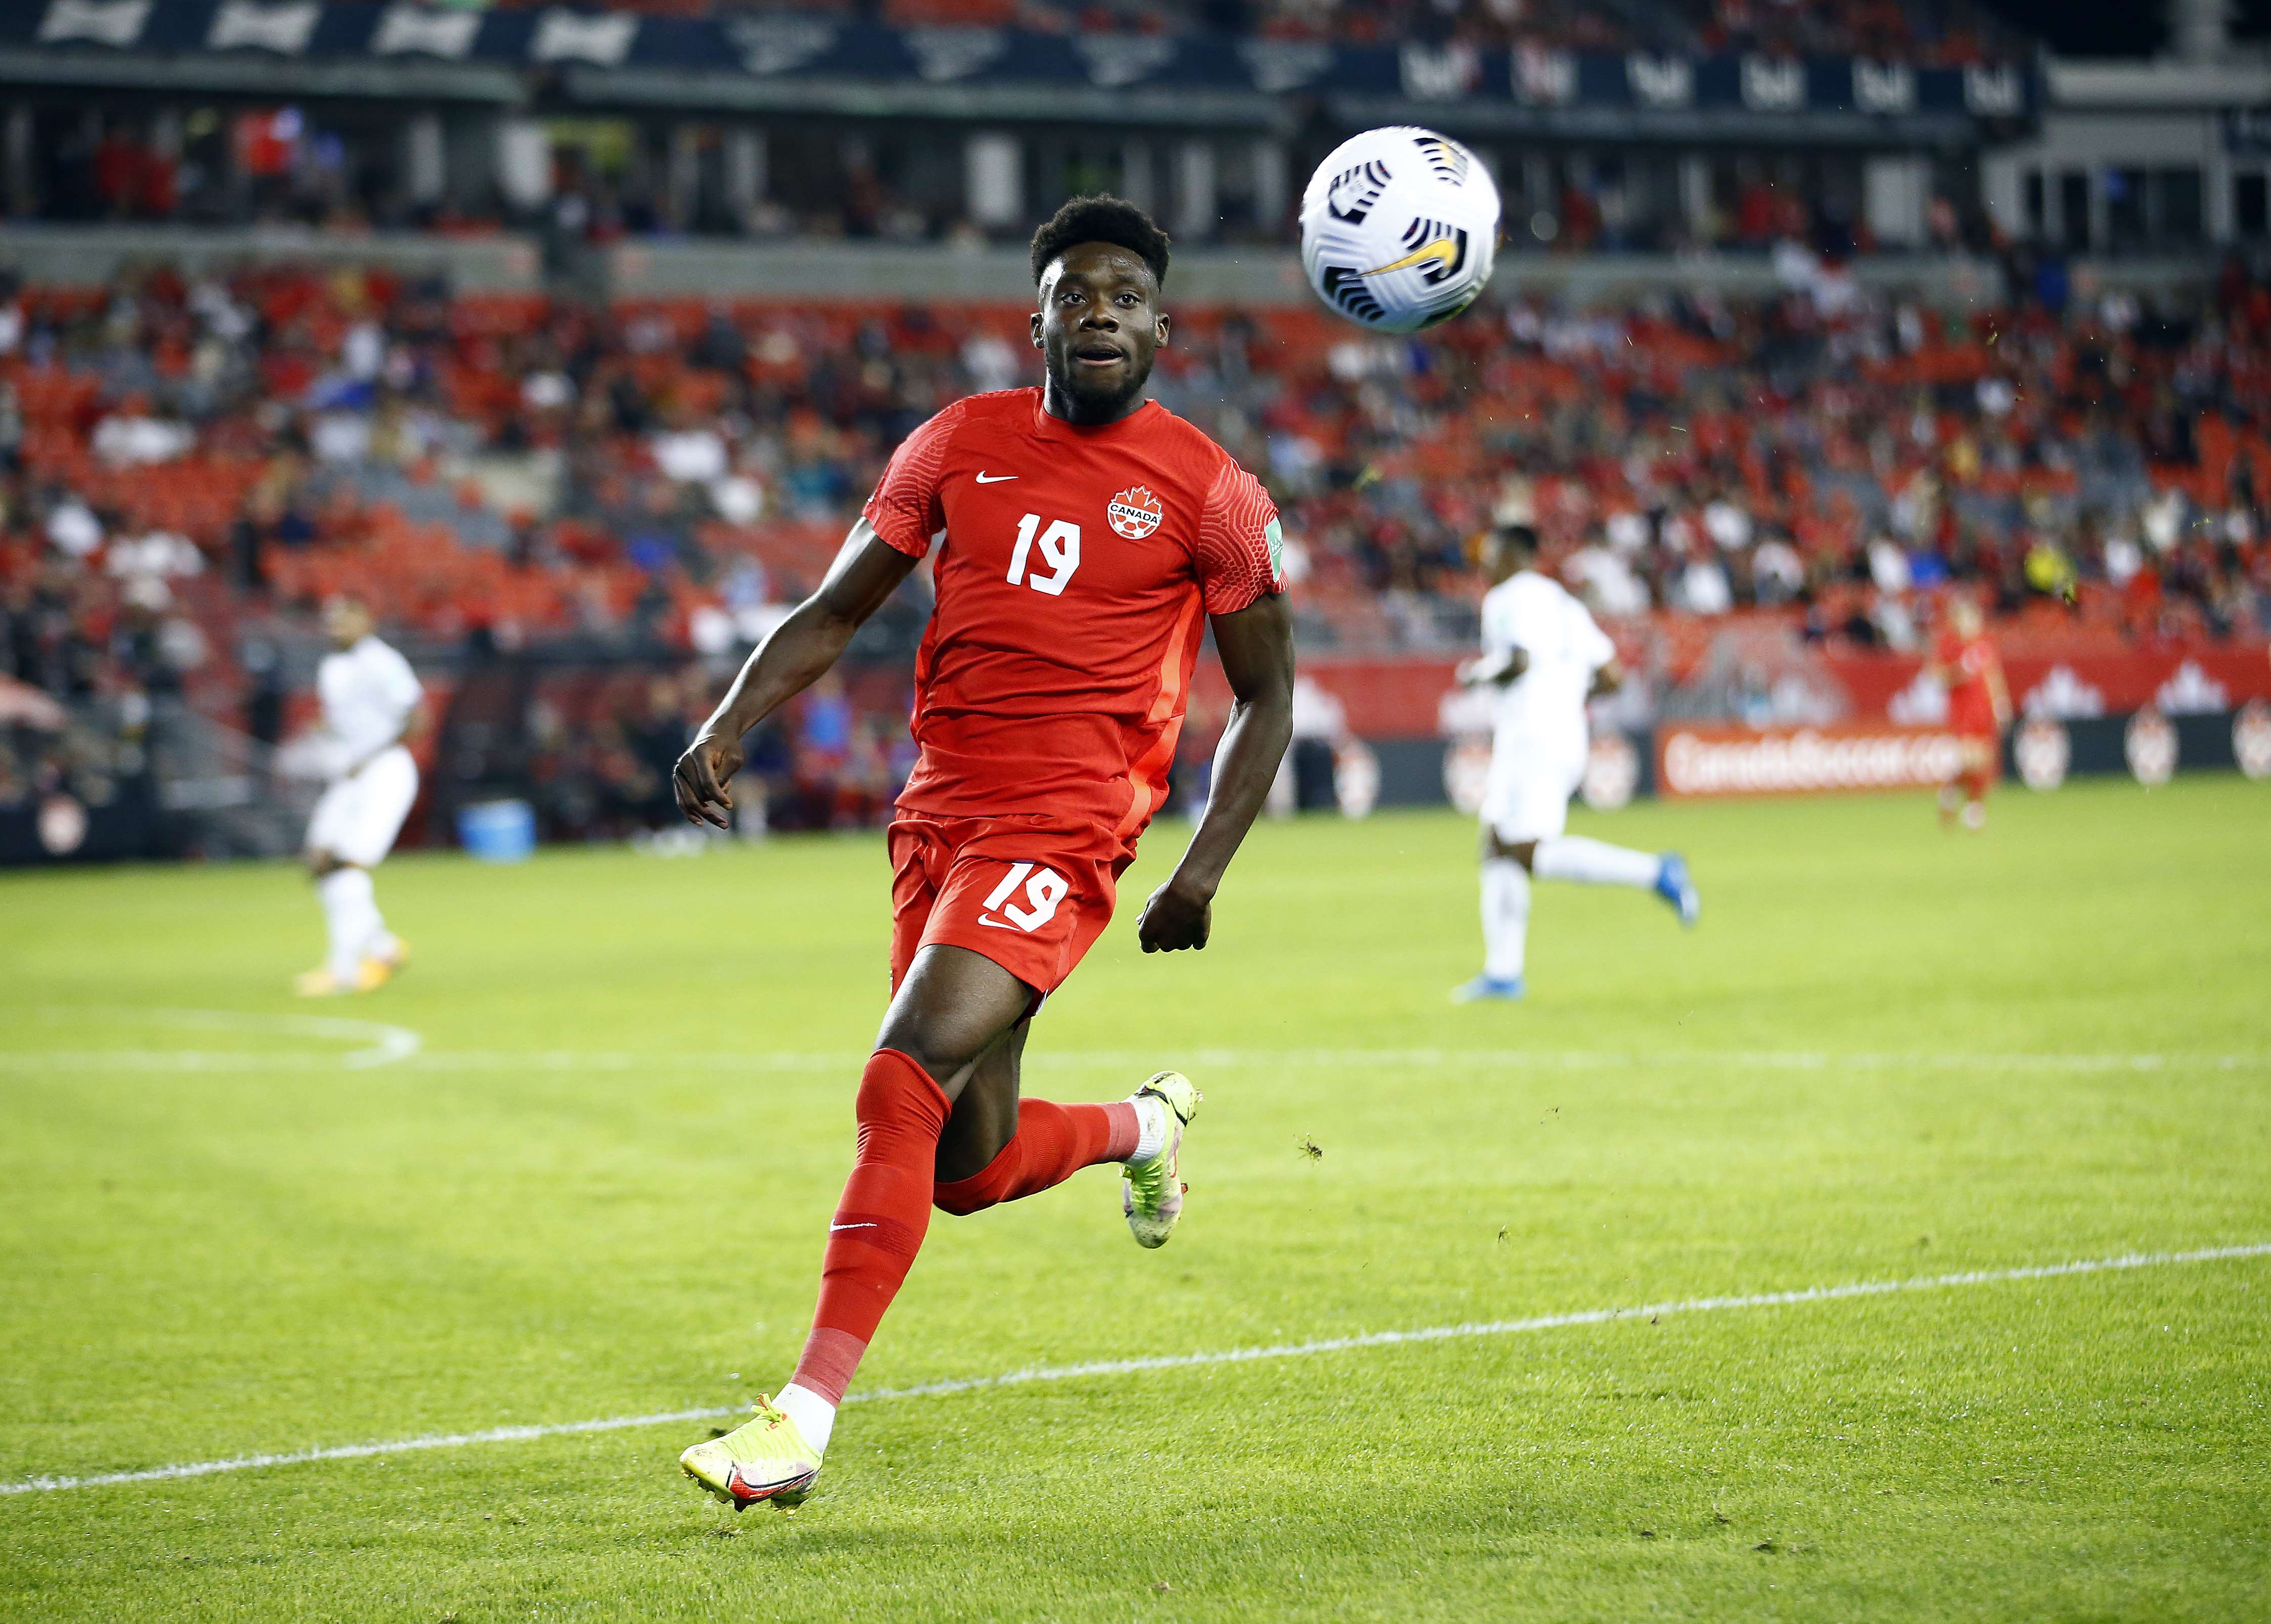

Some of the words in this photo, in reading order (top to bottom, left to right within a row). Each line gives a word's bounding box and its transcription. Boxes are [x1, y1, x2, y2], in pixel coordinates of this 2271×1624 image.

[1110, 505, 1157, 524] CANADA
[1006, 513, 1081, 597] 19
[982, 862, 1069, 933] 19
